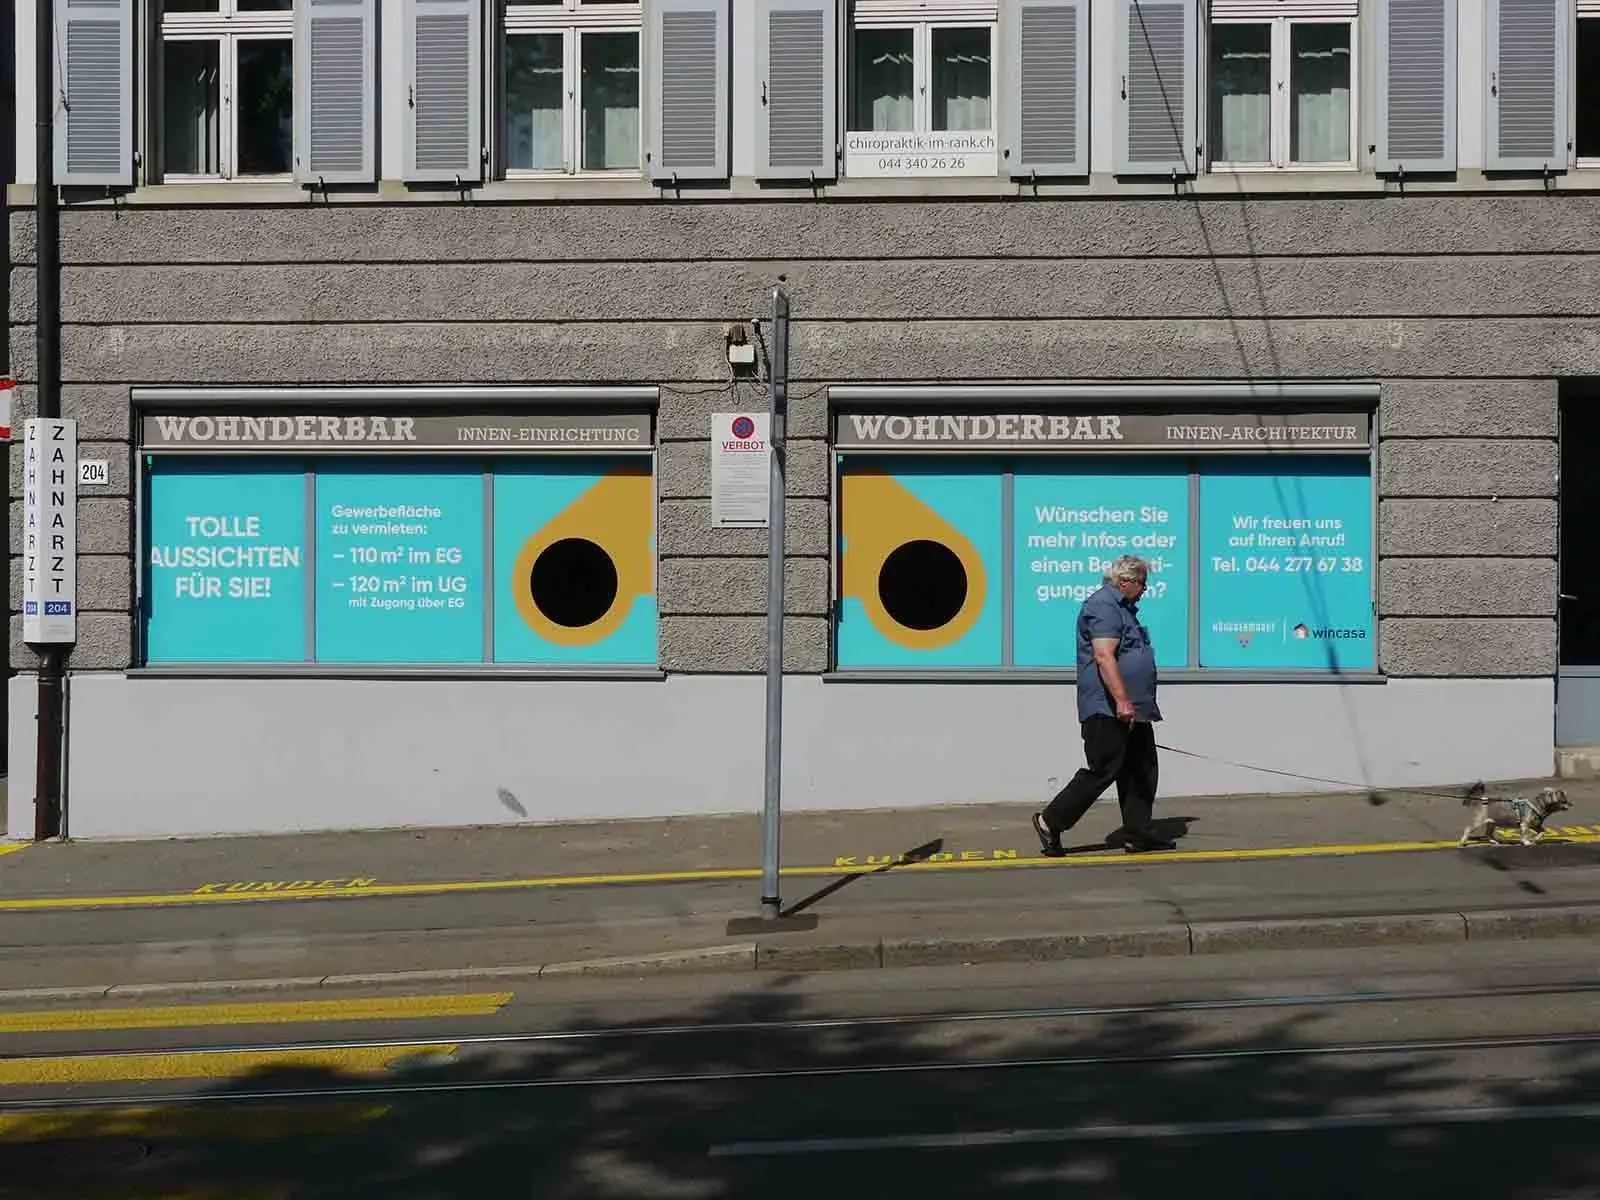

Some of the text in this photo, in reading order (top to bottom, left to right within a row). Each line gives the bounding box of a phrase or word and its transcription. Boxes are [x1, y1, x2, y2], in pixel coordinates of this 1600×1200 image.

[849, 136, 995, 151] chiropraktik-im-rank.ch
[878, 157, 966, 169] 044 340 26 26
[155, 416, 418, 441] WOHNDERBAR
[457, 427, 641, 442] INNEN-EINRICHTUNG
[849, 415, 1124, 441] WOHNDERBAR
[1166, 426, 1358, 441] INNEN-ARCHITEKTUR
[721, 441, 766, 450] VERBOT
[82, 464, 105, 480] 204
[28, 425, 36, 593] ZAHNARZT
[52, 425, 65, 593] ZAHNARZT
[331, 504, 442, 519] Gewerbefläche
[1035, 505, 1169, 523] Wünschen Sie
[186, 516, 261, 538] TOLLE
[331, 521, 428, 535] zu vermieten:
[1233, 516, 1342, 529] Wir freuen uns
[1027, 533, 1177, 548] mehr Infos oder
[1229, 533, 1256, 546] auf
[1258, 533, 1296, 546] Ihren
[151, 546, 301, 568] AUSSICHTEN
[408, 547, 431, 564] im
[436, 547, 463, 564] EG
[1031, 556, 1083, 573] einen
[1212, 556, 1363, 572] Tel. 044 277 67 38
[175, 572, 271, 598] FÜR SIE!
[411, 576, 433, 592] im
[438, 576, 467, 592] UG
[48, 604, 68, 613] 204
[348, 596, 465, 610] mit Zugang über EG
[1312, 626, 1366, 639] wincasa
[193, 878, 377, 894] KUNDEN
